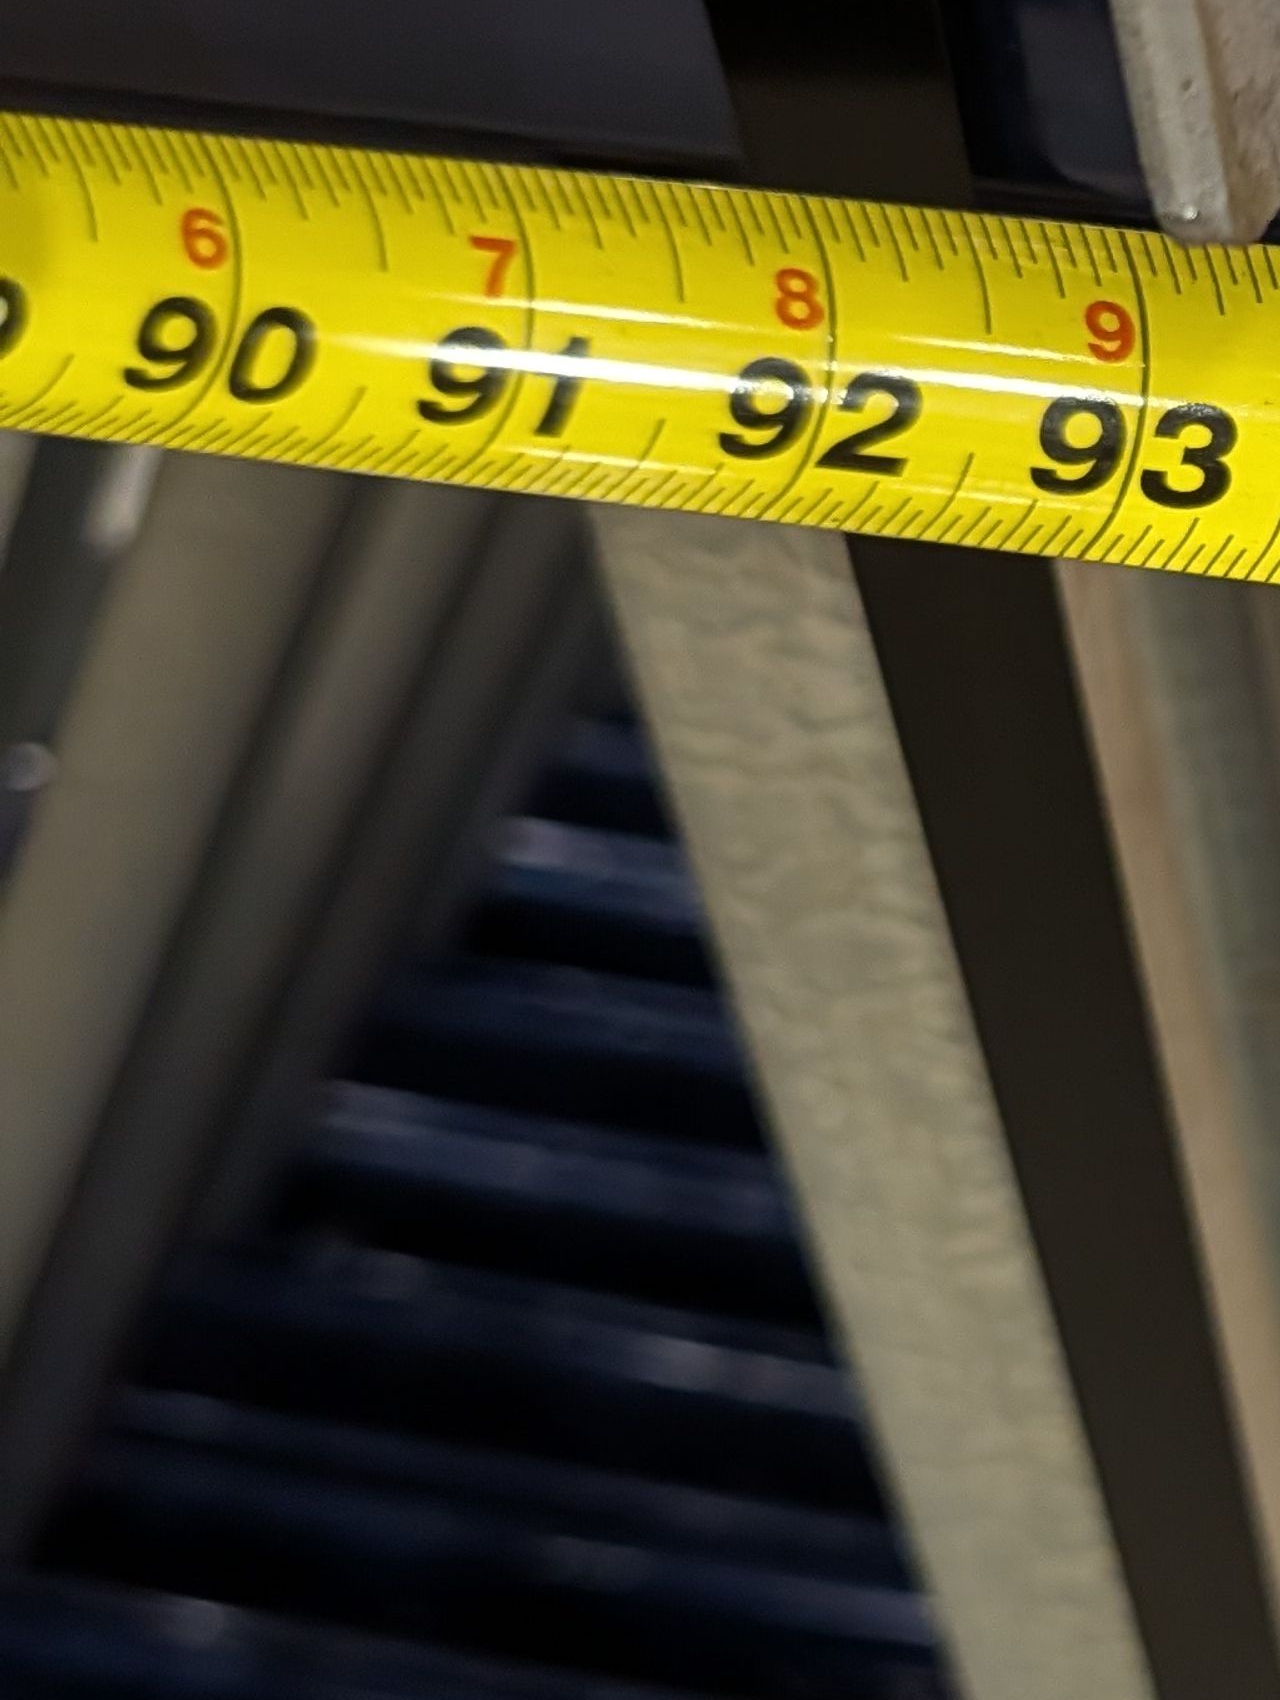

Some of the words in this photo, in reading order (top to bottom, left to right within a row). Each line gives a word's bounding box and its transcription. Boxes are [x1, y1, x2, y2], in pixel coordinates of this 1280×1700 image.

[180, 208, 229, 270] 6
[469, 236, 517, 298] 7
[774, 267, 825, 331] 8
[1083, 301, 1135, 363] 9
[122, 295, 318, 405] 90
[417, 326, 591, 438] 91
[717, 356, 924, 478] 92
[1029, 394, 1238, 509] 93
